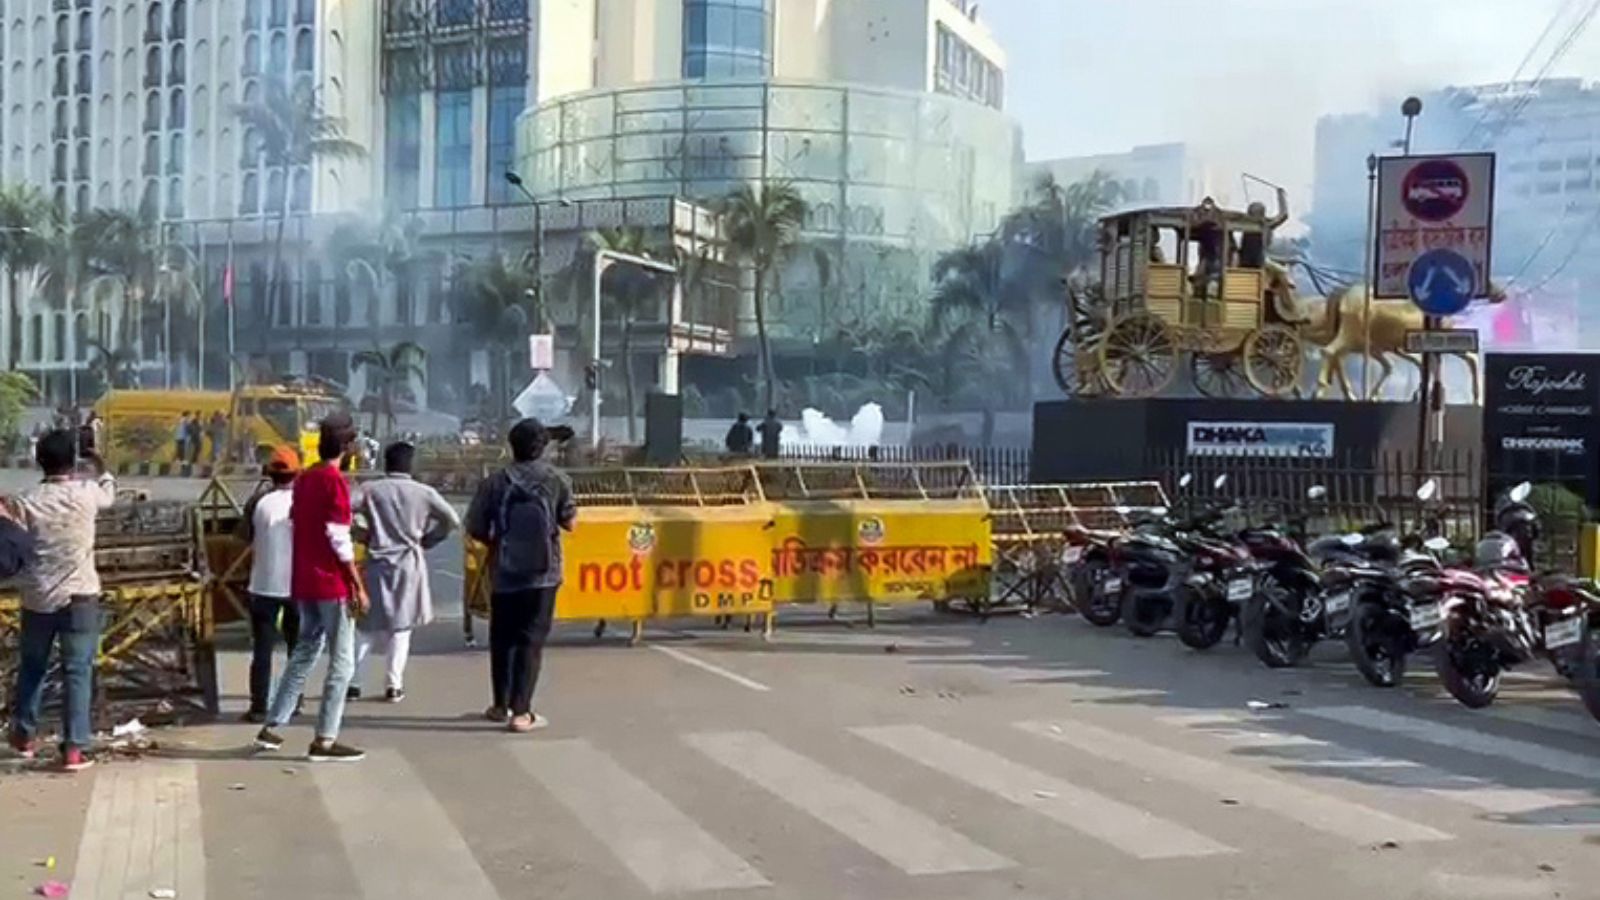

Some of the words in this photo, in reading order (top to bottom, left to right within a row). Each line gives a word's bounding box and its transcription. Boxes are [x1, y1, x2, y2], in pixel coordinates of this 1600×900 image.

[579, 553, 643, 593] not
[655, 558, 760, 590] cross
[857, 545, 947, 577] করবেন
[950, 542, 979, 570] না
